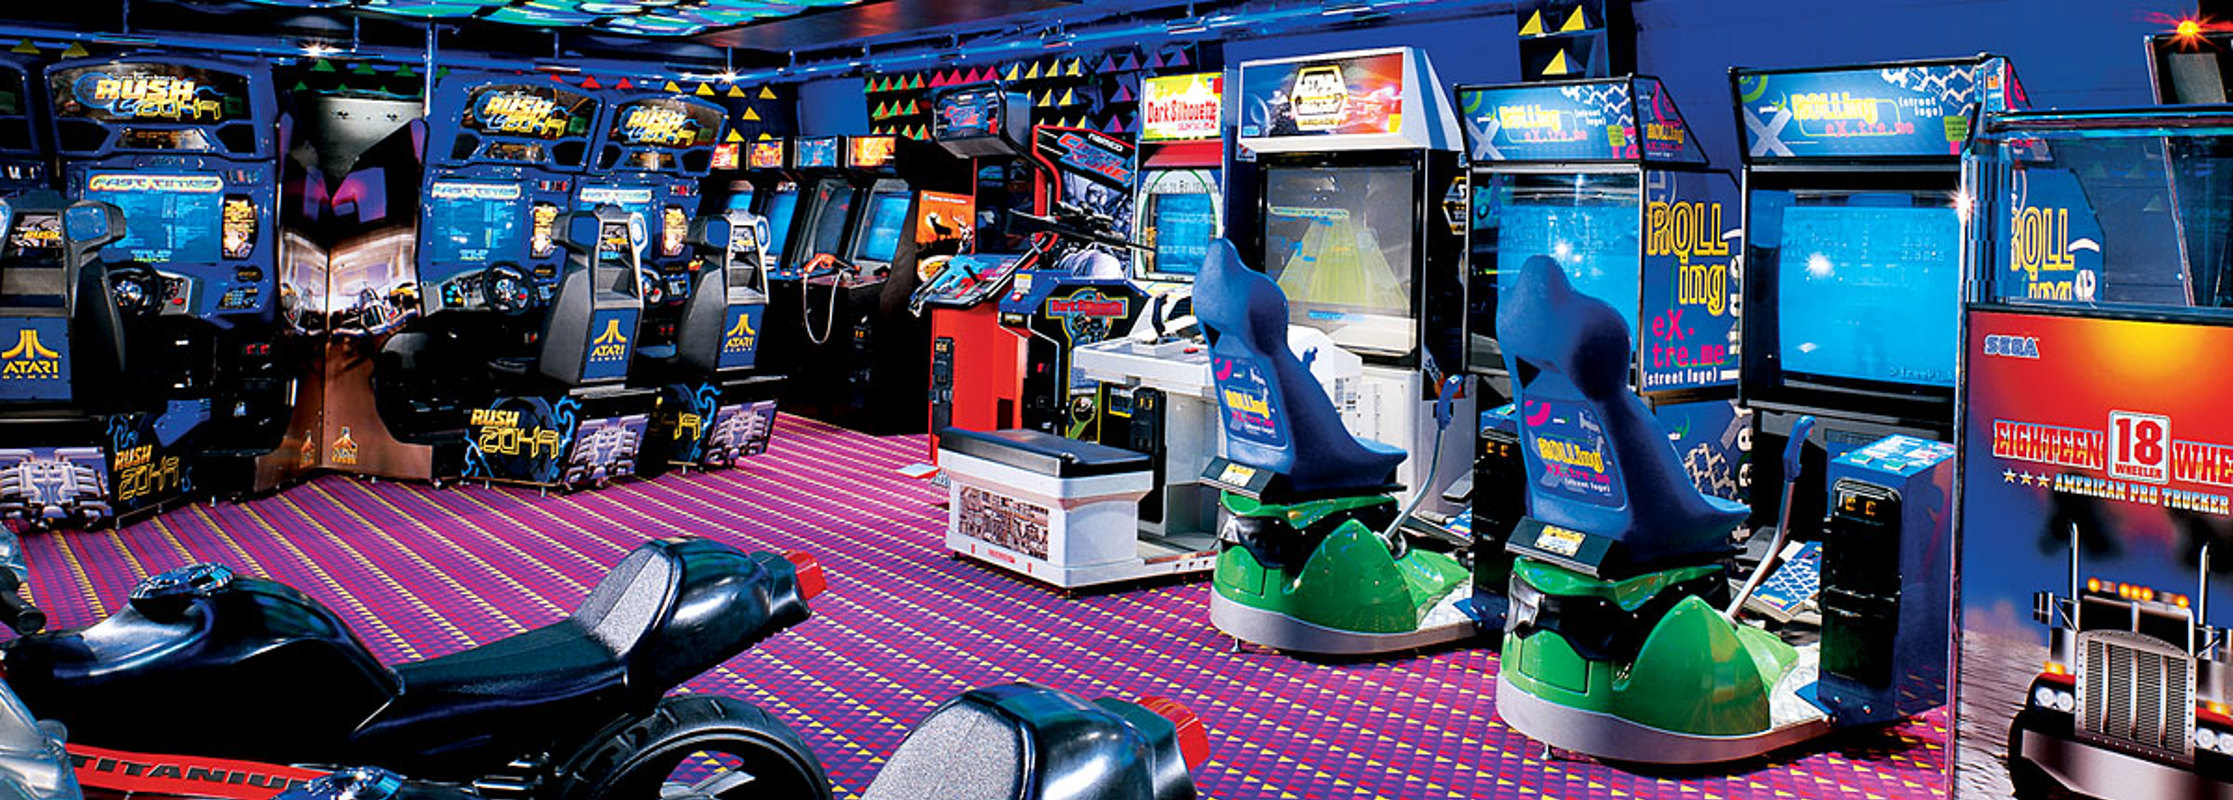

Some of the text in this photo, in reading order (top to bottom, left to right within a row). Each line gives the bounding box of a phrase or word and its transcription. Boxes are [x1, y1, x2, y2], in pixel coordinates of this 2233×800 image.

[95, 79, 195, 100] RUSH
[483, 97, 555, 118] RUSH
[1147, 101, 1169, 124] Dark
[625, 110, 687, 130] RUSH
[1647, 201, 1729, 256] ROLL
[1679, 254, 1726, 316] ing
[592, 344, 626, 357] ATARI
[726, 337, 754, 348] ATARI
[1984, 334, 2040, 359] SEGA
[2, 360, 59, 374] ATARI
[470, 408, 520, 428] RUSH
[477, 425, 560, 459] 2049
[1993, 418, 2104, 470] EIGHTEEN
[2115, 418, 2163, 467] 18
[113, 444, 153, 472] RUSH
[118, 455, 180, 501] 2049
[2114, 463, 2163, 479] WHEELER
[2054, 473, 2230, 515] AMERICAN PRO TRUCKER
